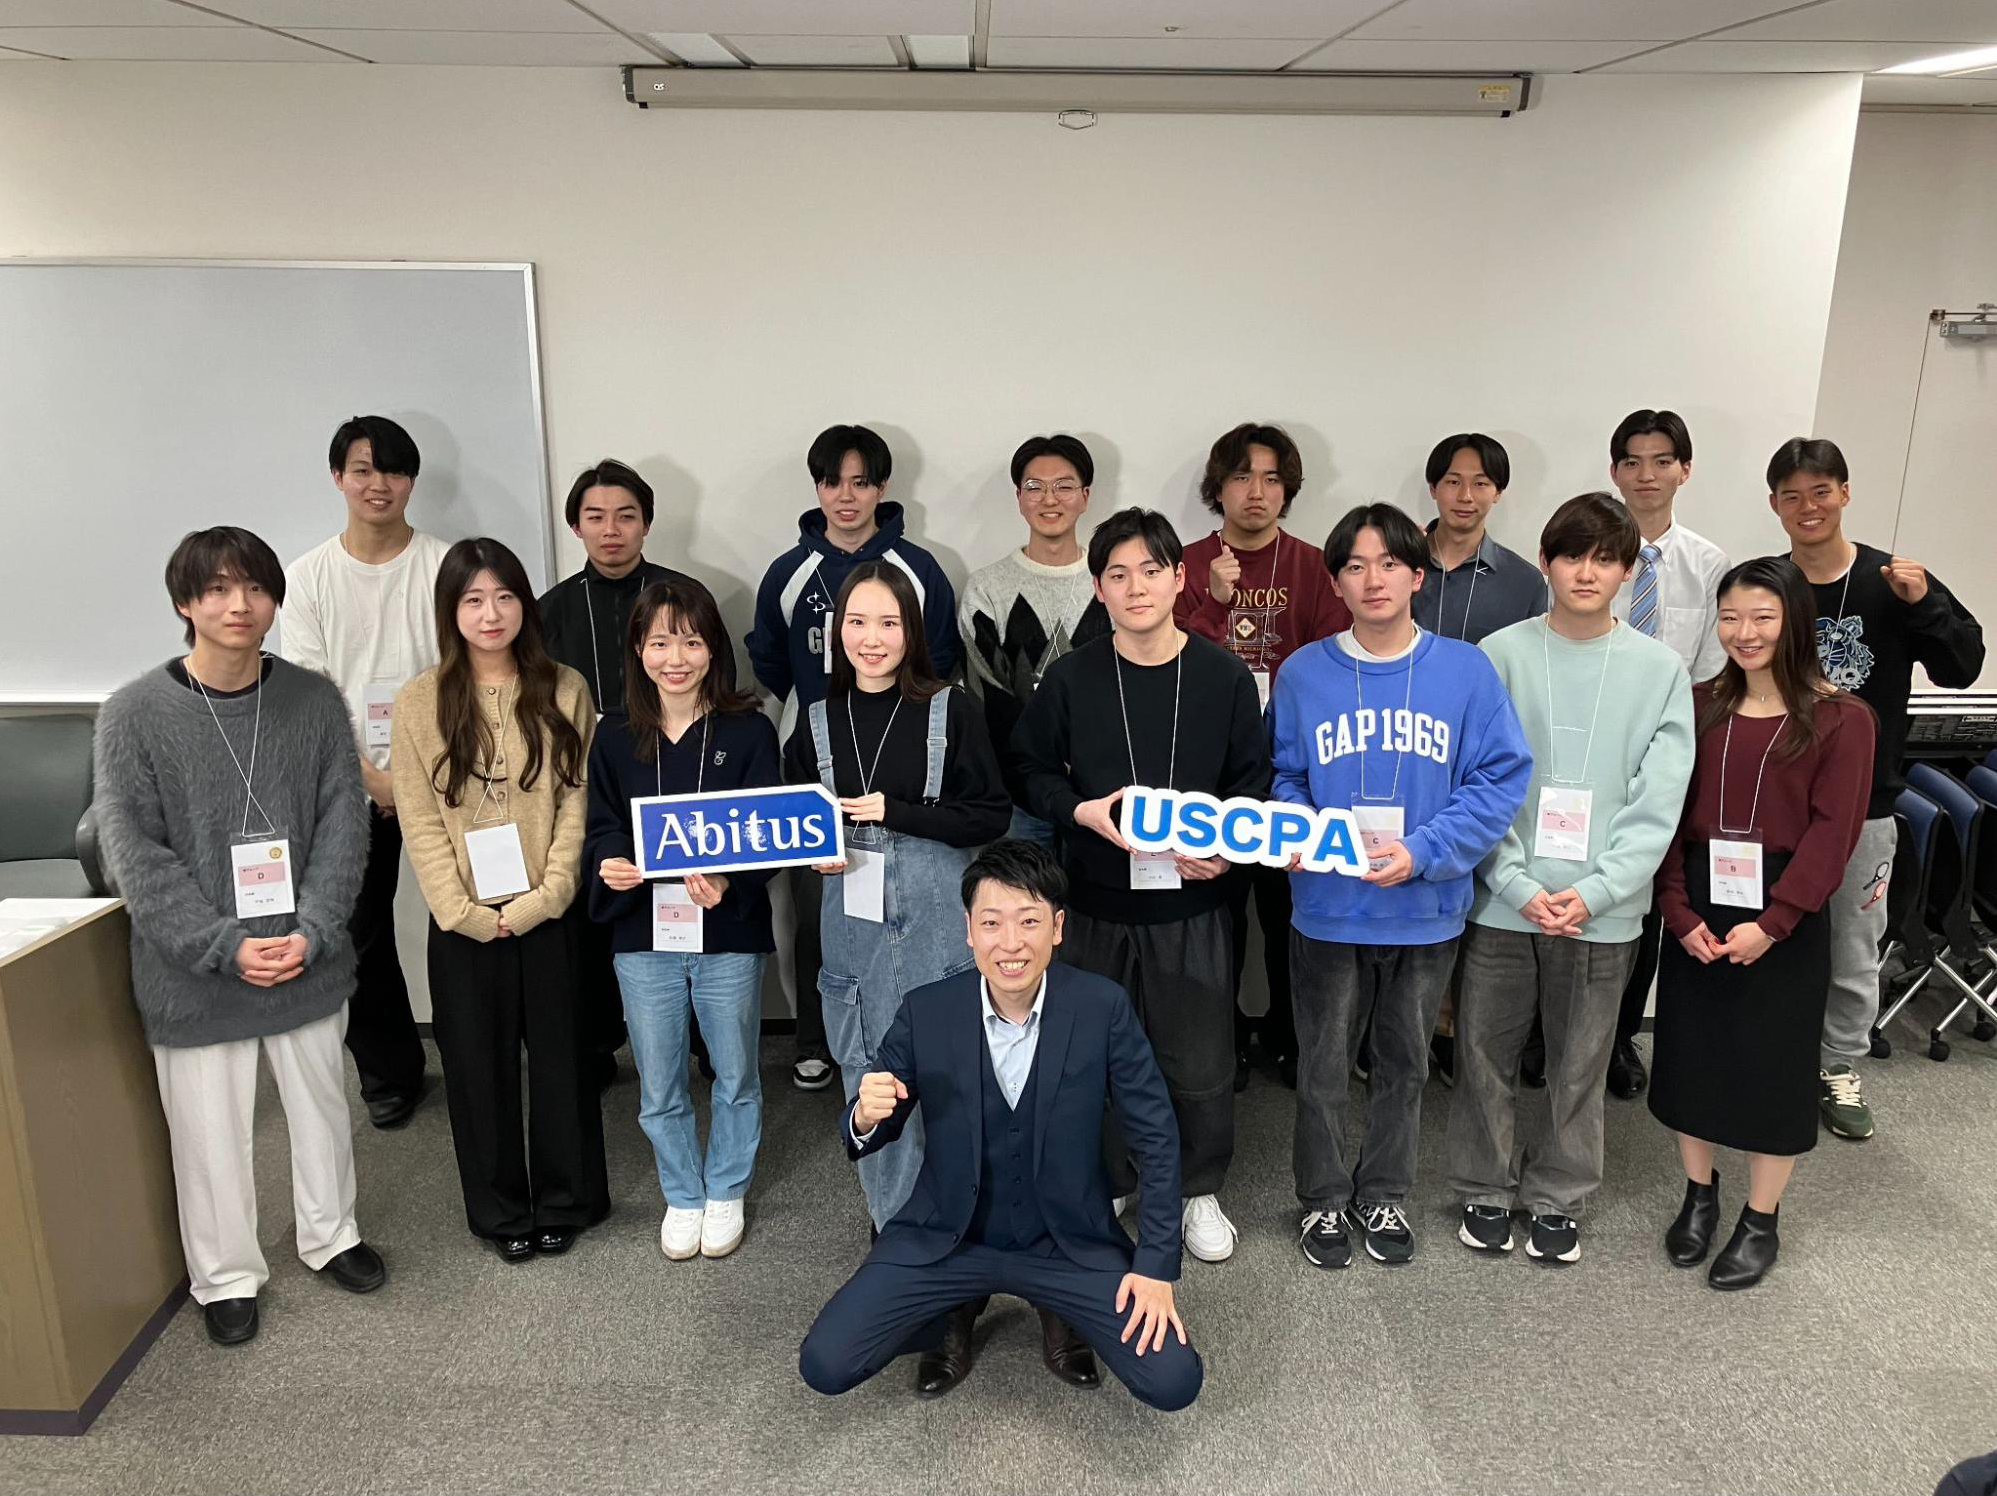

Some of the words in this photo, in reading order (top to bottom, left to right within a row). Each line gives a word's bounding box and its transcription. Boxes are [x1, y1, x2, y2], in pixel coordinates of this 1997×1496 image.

[1315, 708, 1376, 765] GAP
[1381, 708, 1449, 764] 1969
[655, 808, 826, 860] Abitus
[1131, 795, 1359, 866] USCPA
[1559, 820, 1567, 828] C
[1372, 837, 1379, 845] C
[673, 911, 680, 919] D
